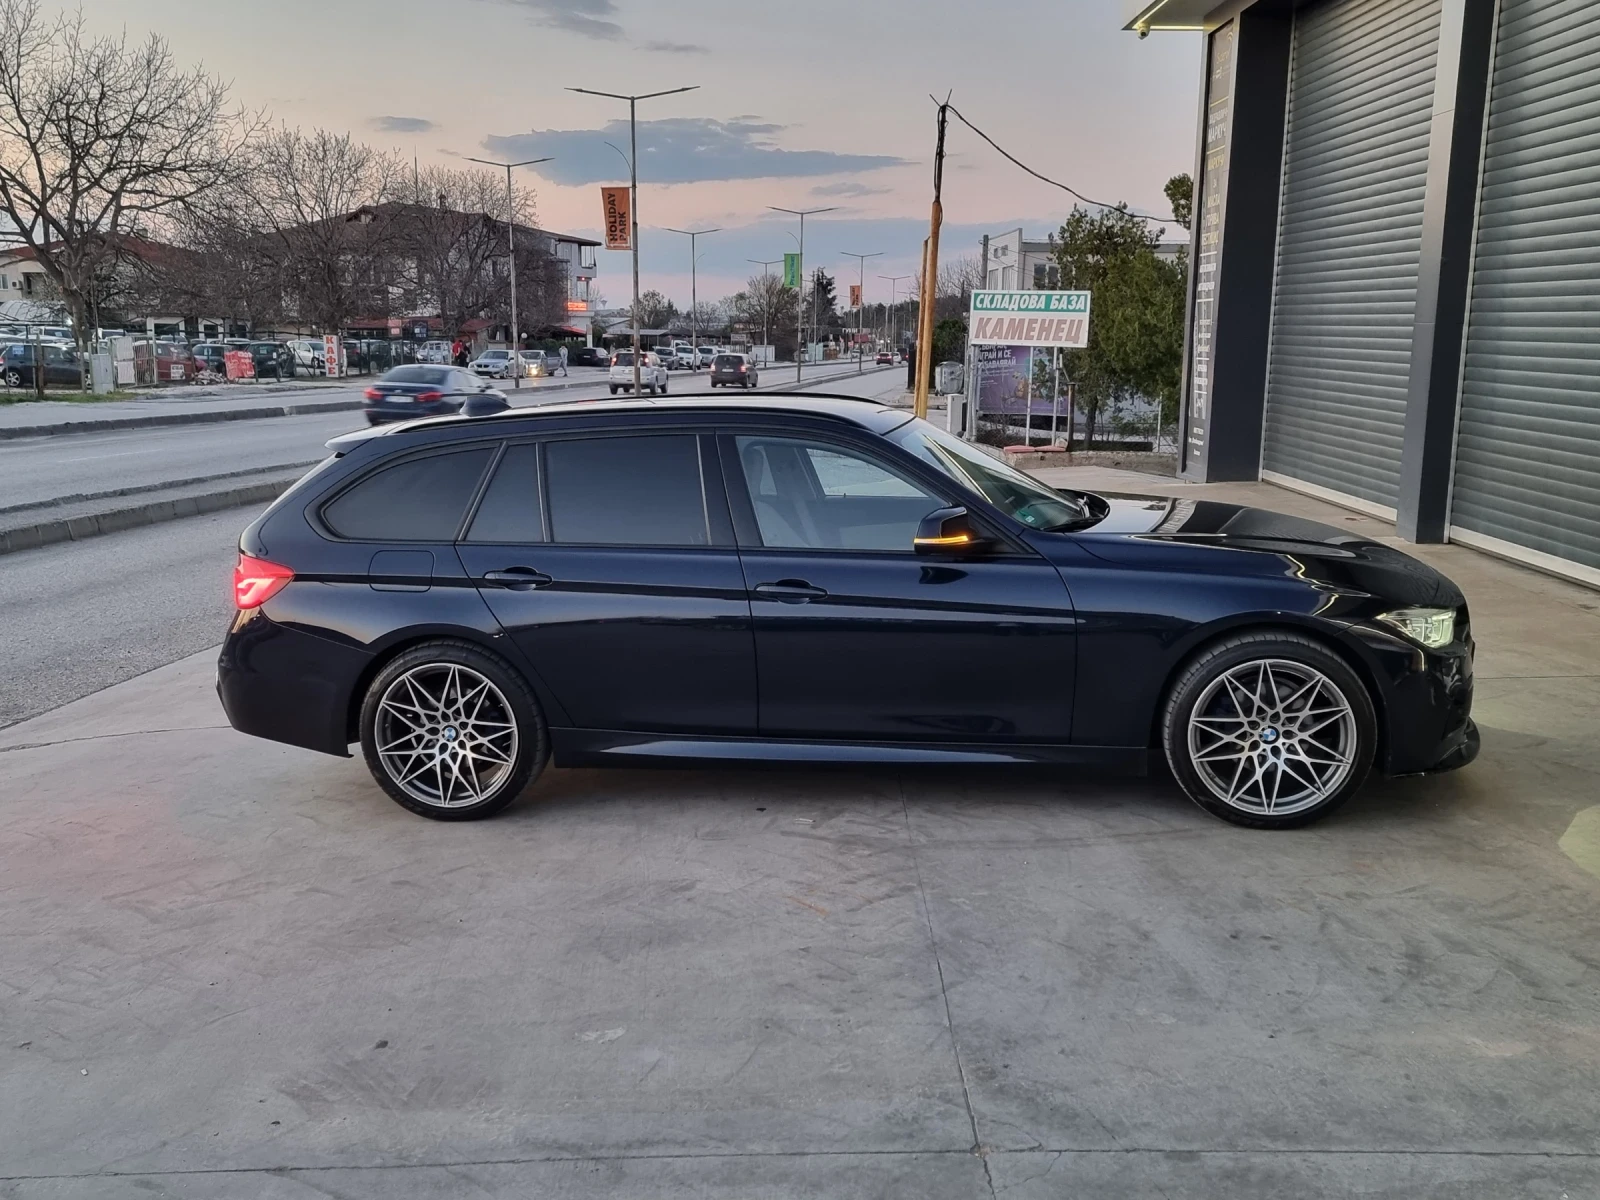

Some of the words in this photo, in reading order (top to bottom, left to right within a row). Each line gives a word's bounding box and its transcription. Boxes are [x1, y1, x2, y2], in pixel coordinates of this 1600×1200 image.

[607, 193, 618, 242] HOLIDAY
[618, 211, 627, 241] PARK
[976, 294, 1045, 310] СКЛАДОВА
[1050, 295, 1085, 310] БАЗА
[974, 317, 1083, 344] КАМЕНЕЦ
[325, 336, 337, 375] КАФЕ
